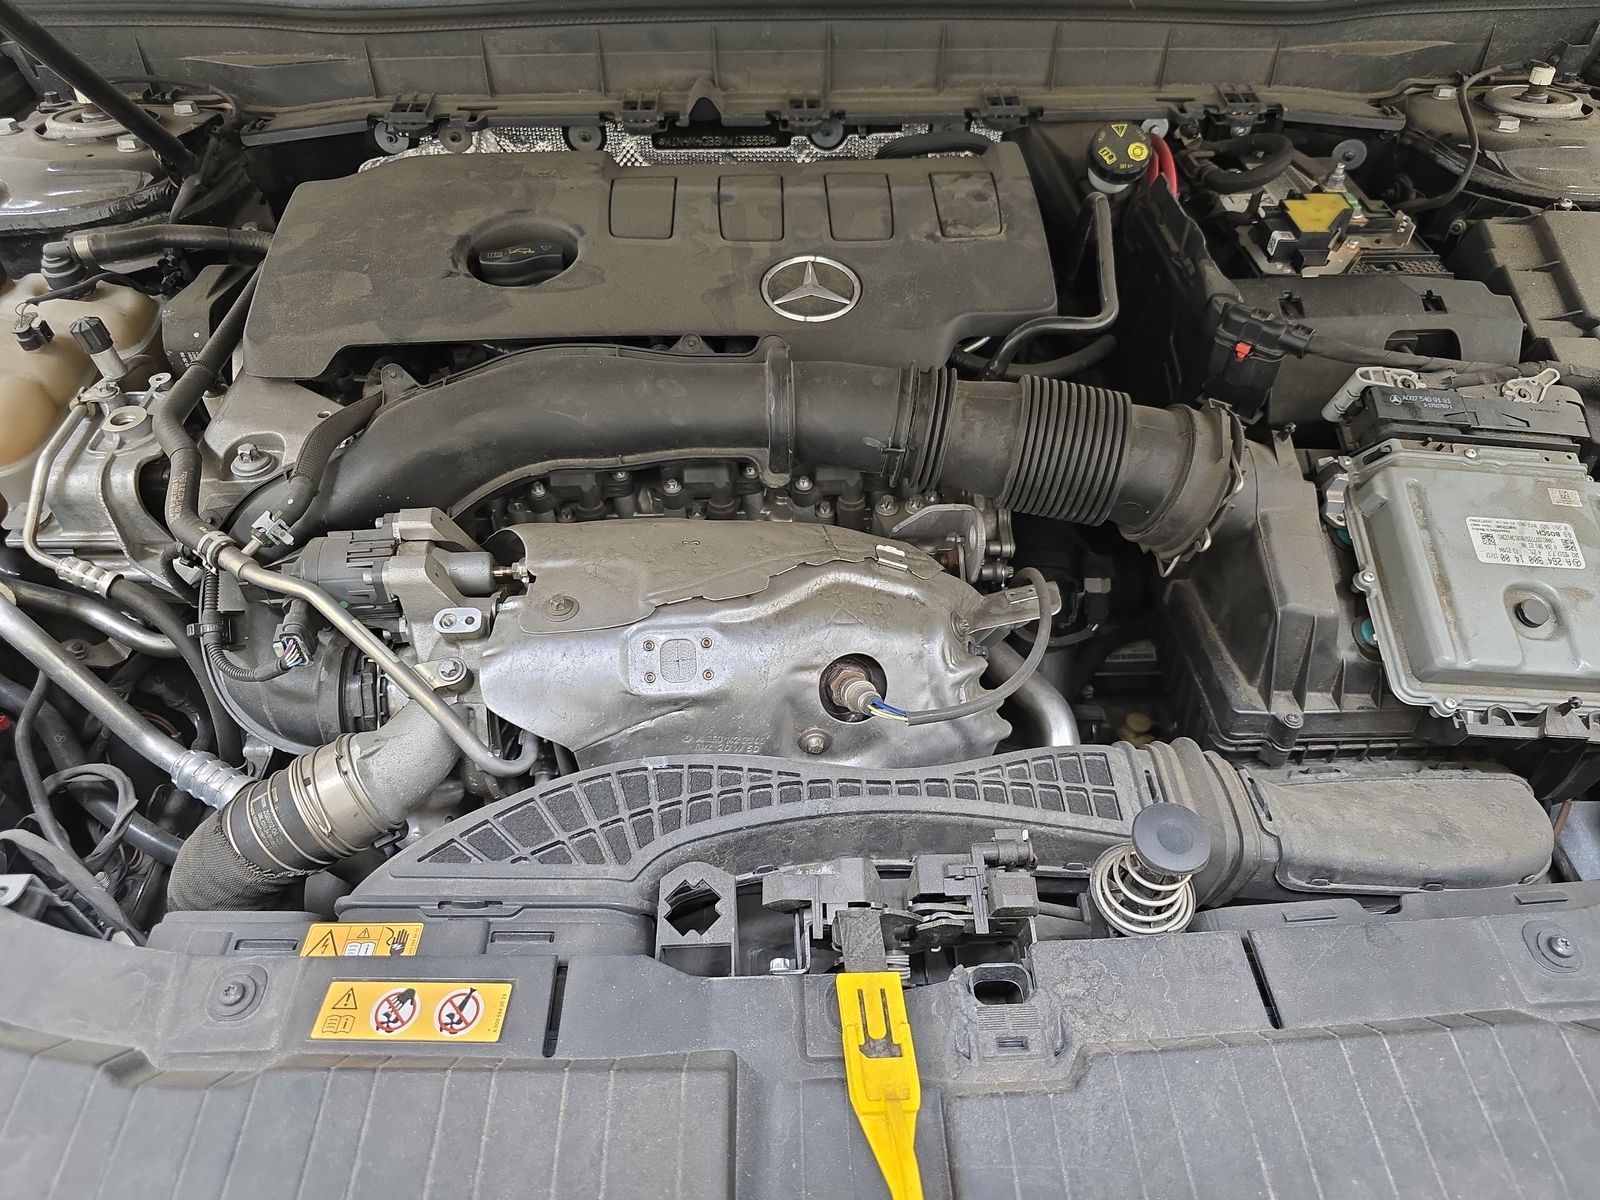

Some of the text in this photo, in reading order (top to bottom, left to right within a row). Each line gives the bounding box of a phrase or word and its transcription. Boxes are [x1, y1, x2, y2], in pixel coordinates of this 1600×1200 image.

[1536, 529, 1561, 537] BOSCH
[1500, 553, 1511, 562] 00
[1514, 555, 1525, 563] 14
[1528, 555, 1544, 565] 900
[1548, 556, 1563, 566] 264
